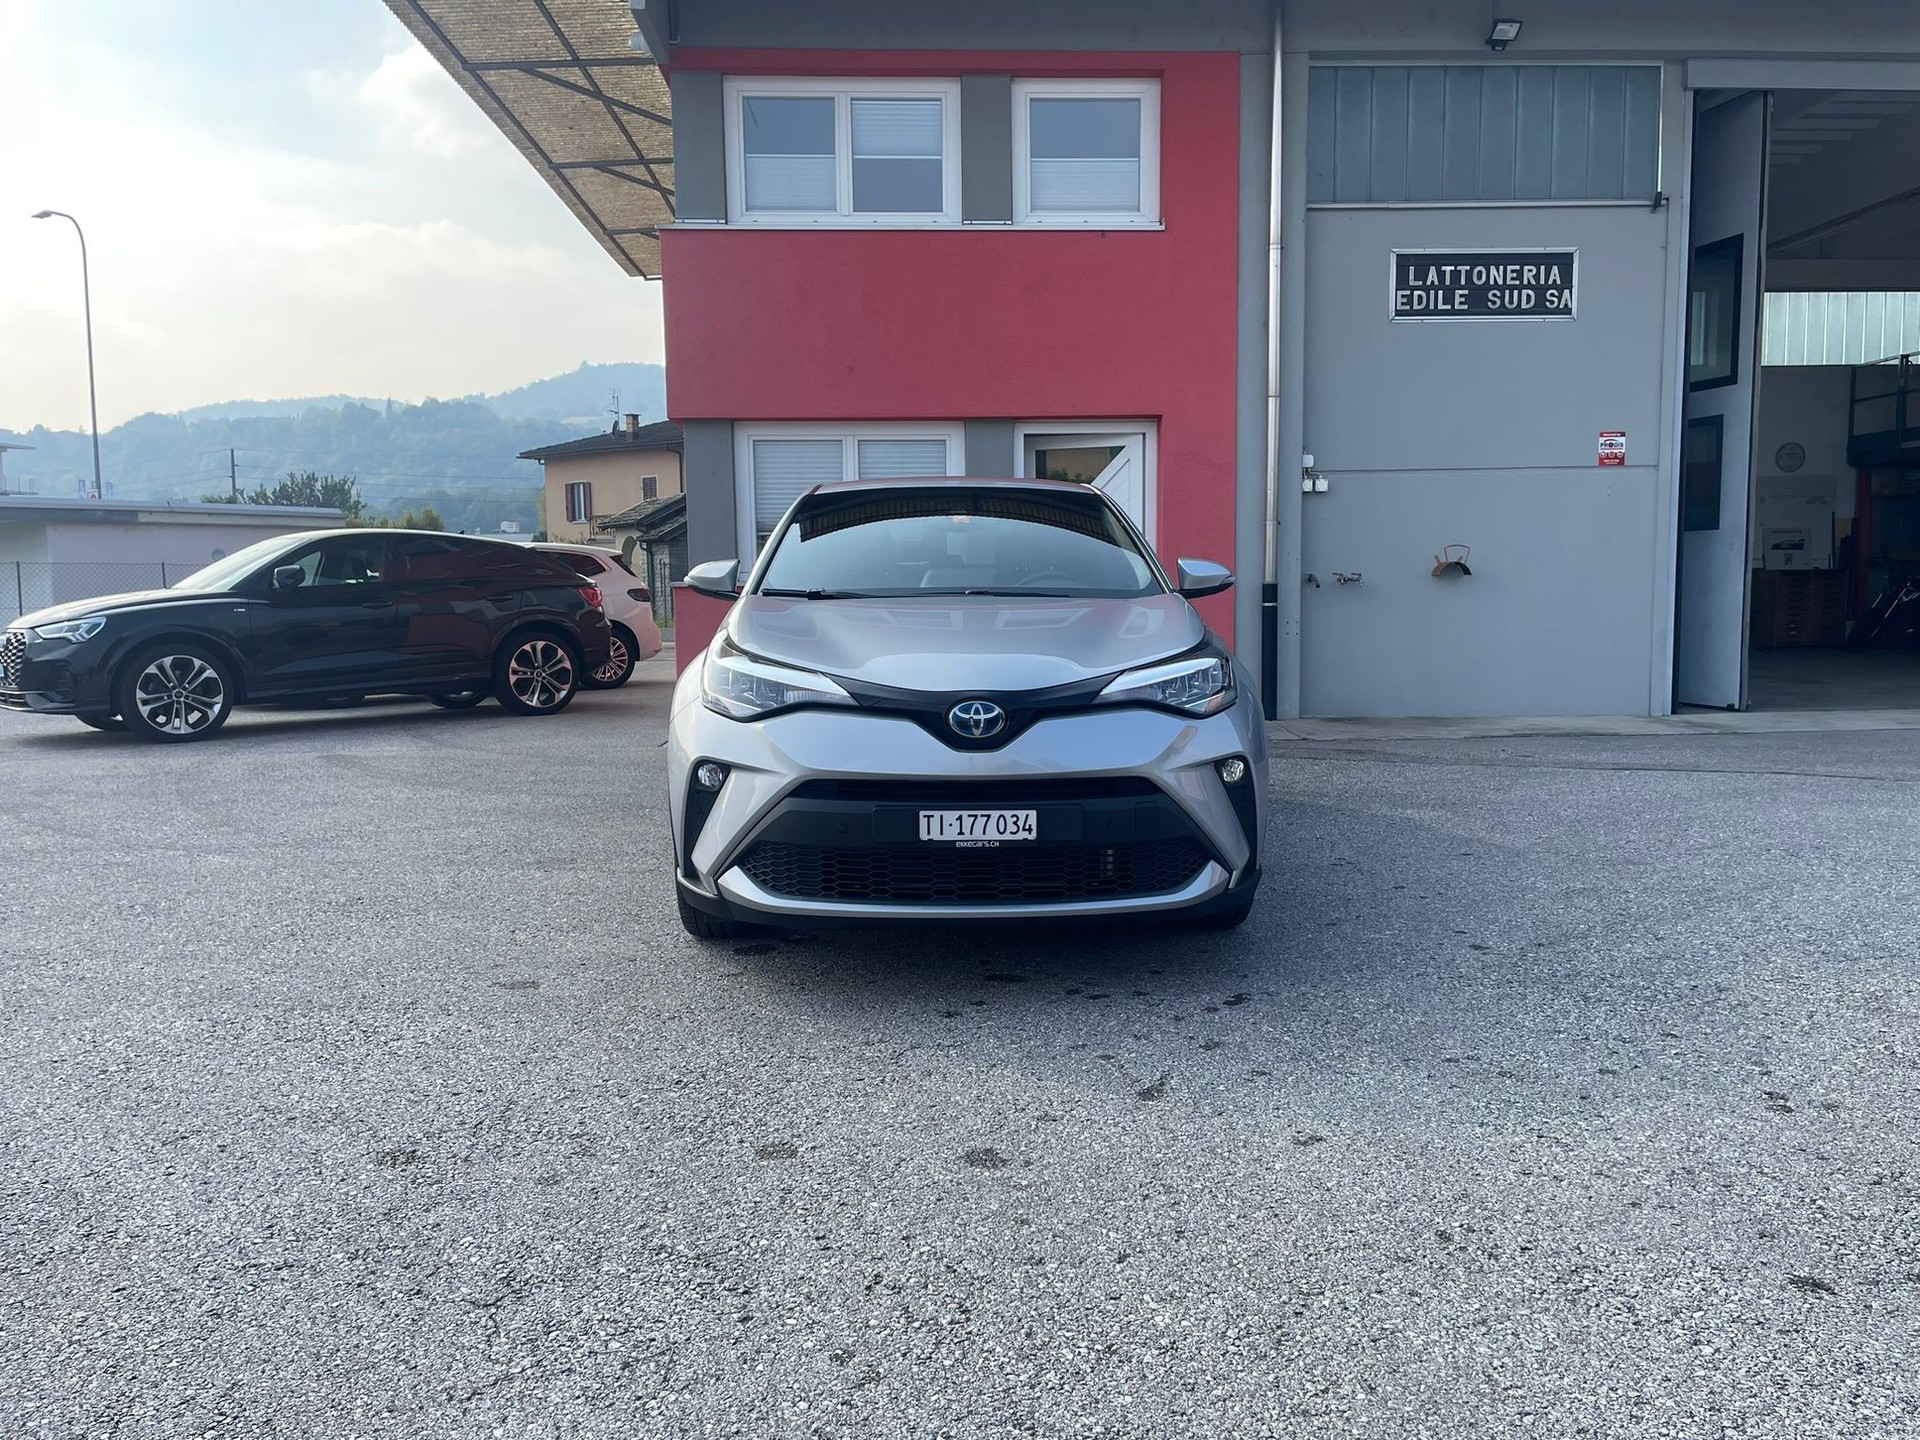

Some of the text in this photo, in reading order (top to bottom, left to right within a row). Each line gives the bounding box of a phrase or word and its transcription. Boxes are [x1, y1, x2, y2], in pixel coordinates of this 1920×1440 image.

[1409, 265, 1561, 286] LATTONERIA
[1396, 289, 1572, 310] EDILE SUD SA
